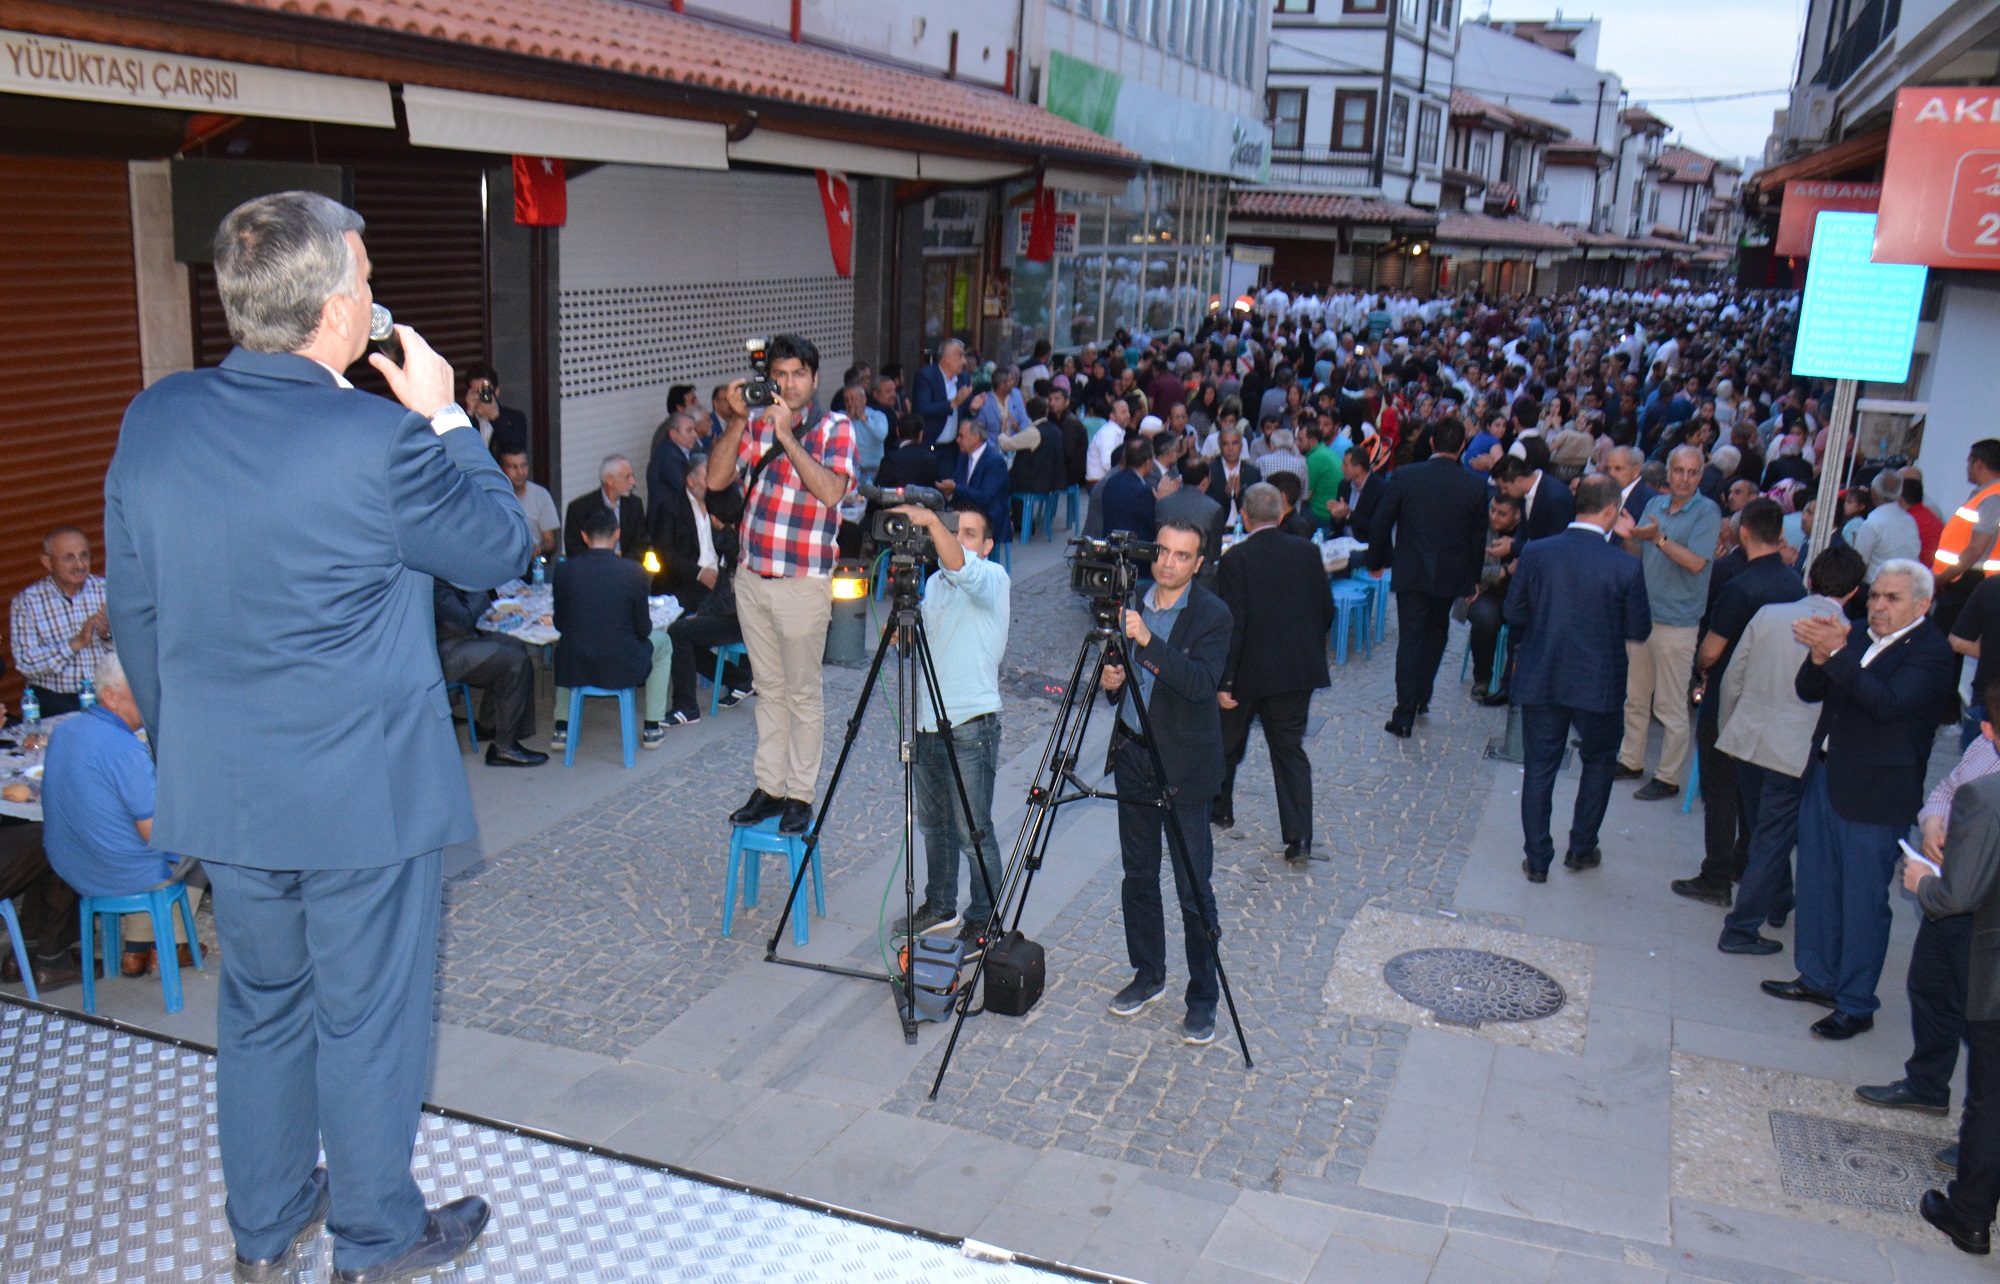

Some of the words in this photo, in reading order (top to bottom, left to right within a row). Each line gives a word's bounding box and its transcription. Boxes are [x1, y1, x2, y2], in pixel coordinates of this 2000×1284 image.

[6, 38, 145, 93] YÜZÜKTAŞI
[152, 62, 238, 103] ÇARŞISI
[1793, 184, 1881, 199] AKBANK
